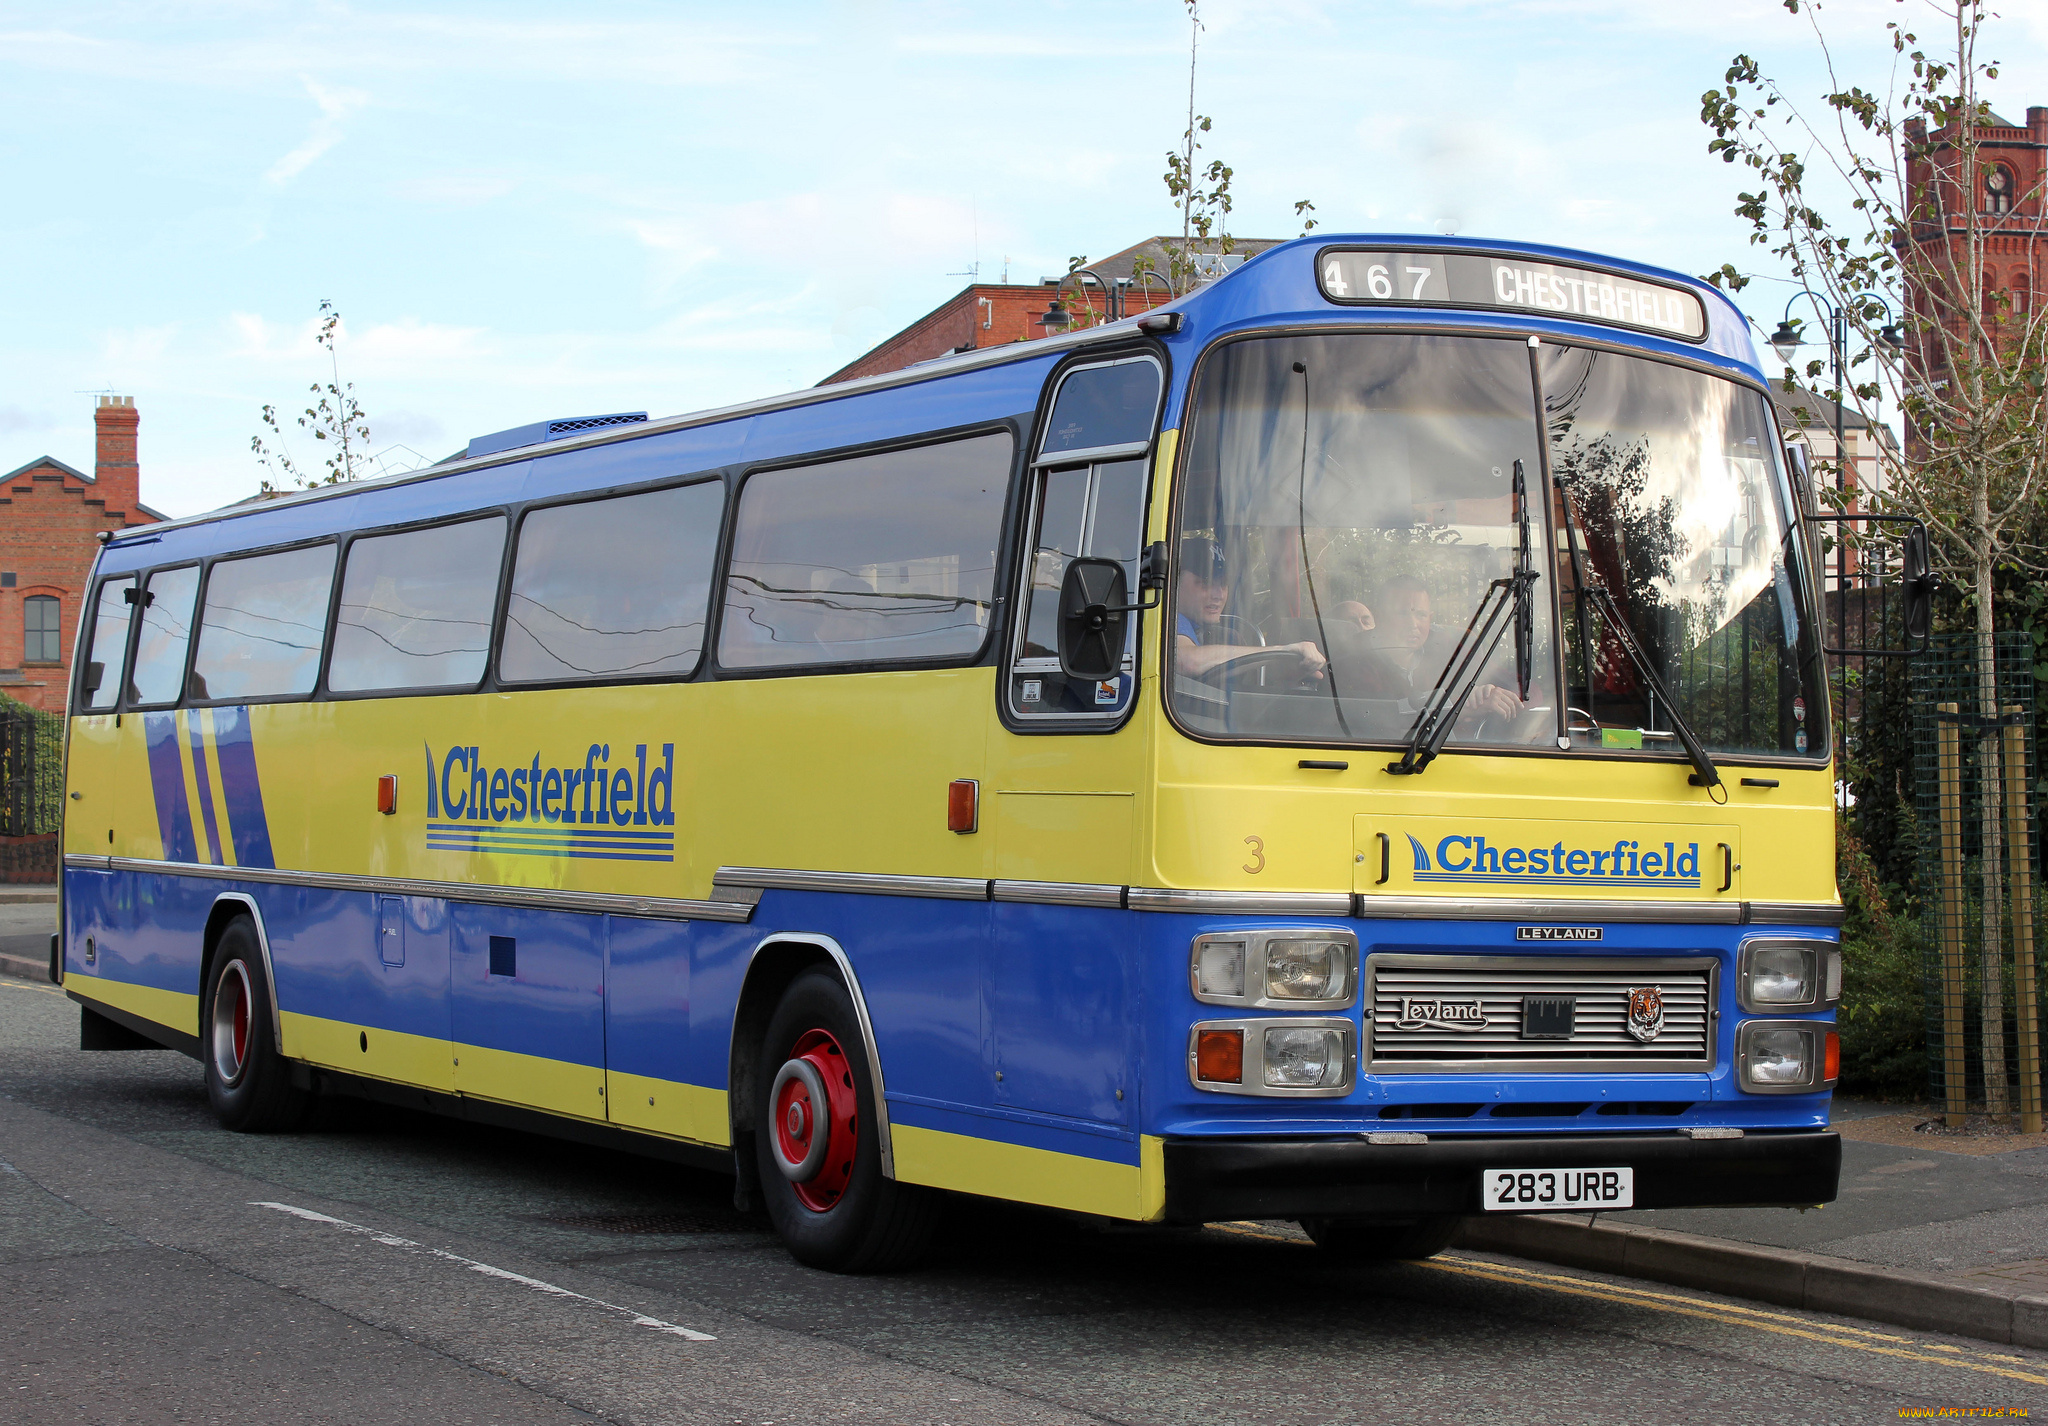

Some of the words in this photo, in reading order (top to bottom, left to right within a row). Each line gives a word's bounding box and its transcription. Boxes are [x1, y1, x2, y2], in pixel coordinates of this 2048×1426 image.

[1496, 266, 1685, 330] CHESTERFIELD
[441, 743, 674, 826] Chesterfield
[1242, 835, 1265, 874] 3
[1436, 835, 1700, 877] Chesterfield
[1522, 928, 1598, 939] LEYLAND
[1396, 996, 1488, 1030] Leyland
[1498, 1173, 1555, 1202] 283
[1564, 1172, 1618, 1201] URB
